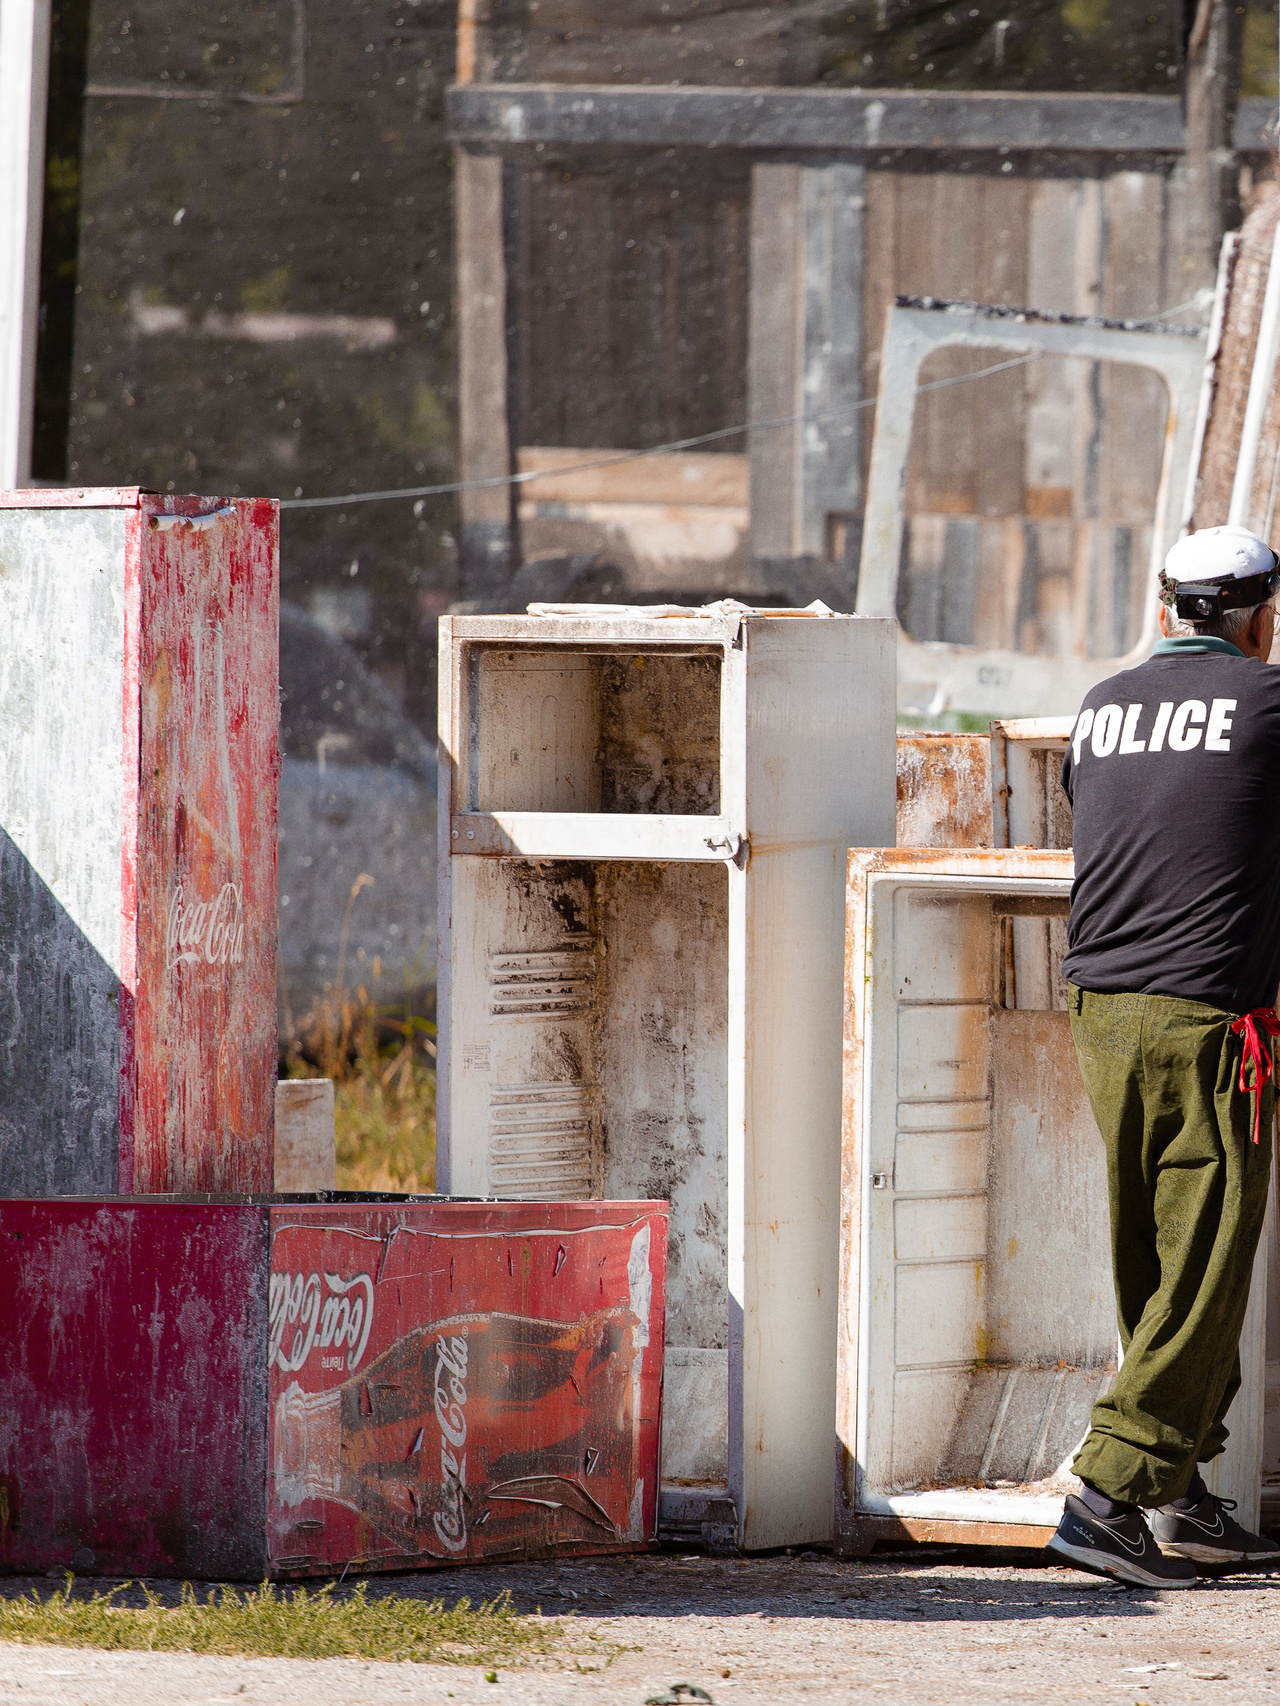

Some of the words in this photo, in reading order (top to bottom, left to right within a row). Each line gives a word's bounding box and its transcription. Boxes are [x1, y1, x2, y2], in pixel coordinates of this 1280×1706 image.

[1072, 698, 1238, 766] POLICE
[166, 881, 244, 970] Coca-Cola
[268, 1270, 374, 1373] Coca-Cola
[321, 1356, 344, 1371] Пейте
[434, 1334, 469, 1550] Coca-Cola
[1072, 1525, 1096, 1545] PEGASUS
